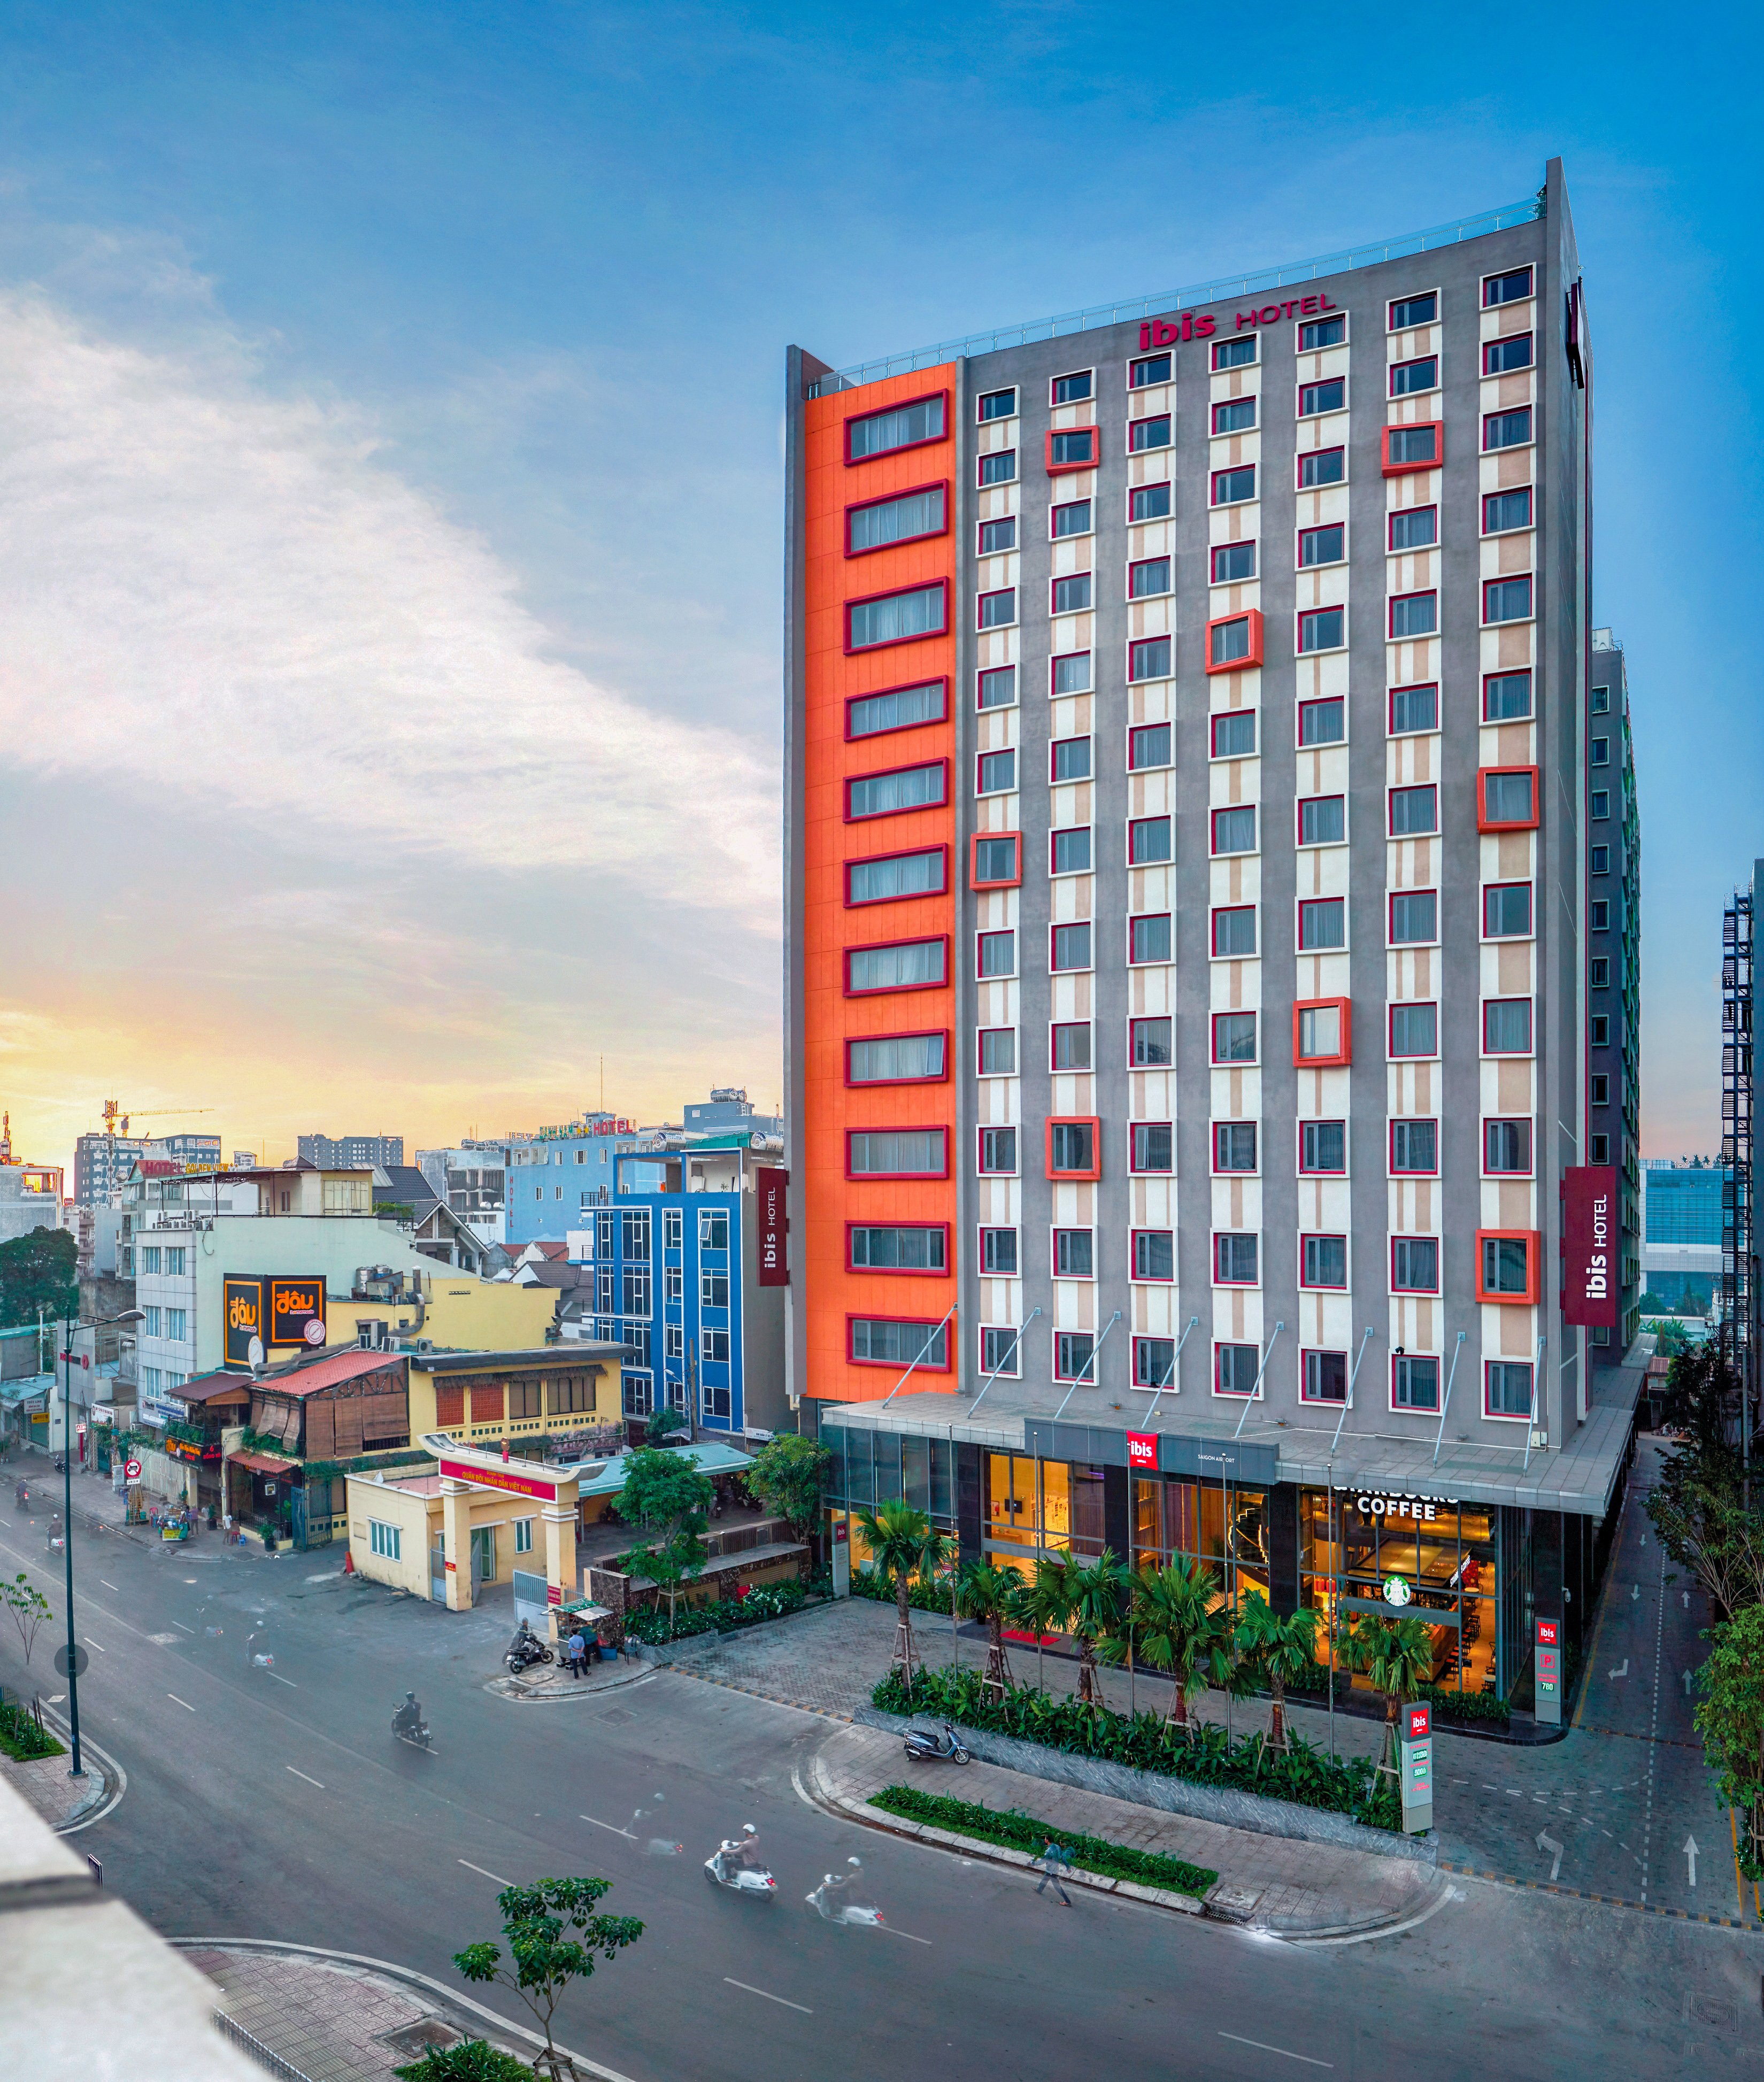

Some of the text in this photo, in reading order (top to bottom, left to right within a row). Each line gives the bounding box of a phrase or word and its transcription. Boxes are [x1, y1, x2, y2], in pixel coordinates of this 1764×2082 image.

[1139, 294, 1336, 351] ibis HOTEL
[594, 1119, 633, 1136] HOTEL
[145, 1162, 184, 1175] HOTEL
[186, 1162, 211, 1174] GOLDEN
[764, 1233, 776, 1268] ibis
[1586, 1194, 1607, 1299] ibis HOTEL
[1130, 1440, 1152, 1458] ibis
[462, 1471, 532, 1493] QUÂN ĐỘI NHÂN DÂN VIỆT NAM
[1357, 1497, 1436, 1521] COFFEE
[837, 1528, 845, 1536] ibis
[1540, 1627, 1554, 1638] ibis
[1413, 1716, 1426, 1728] ibis
